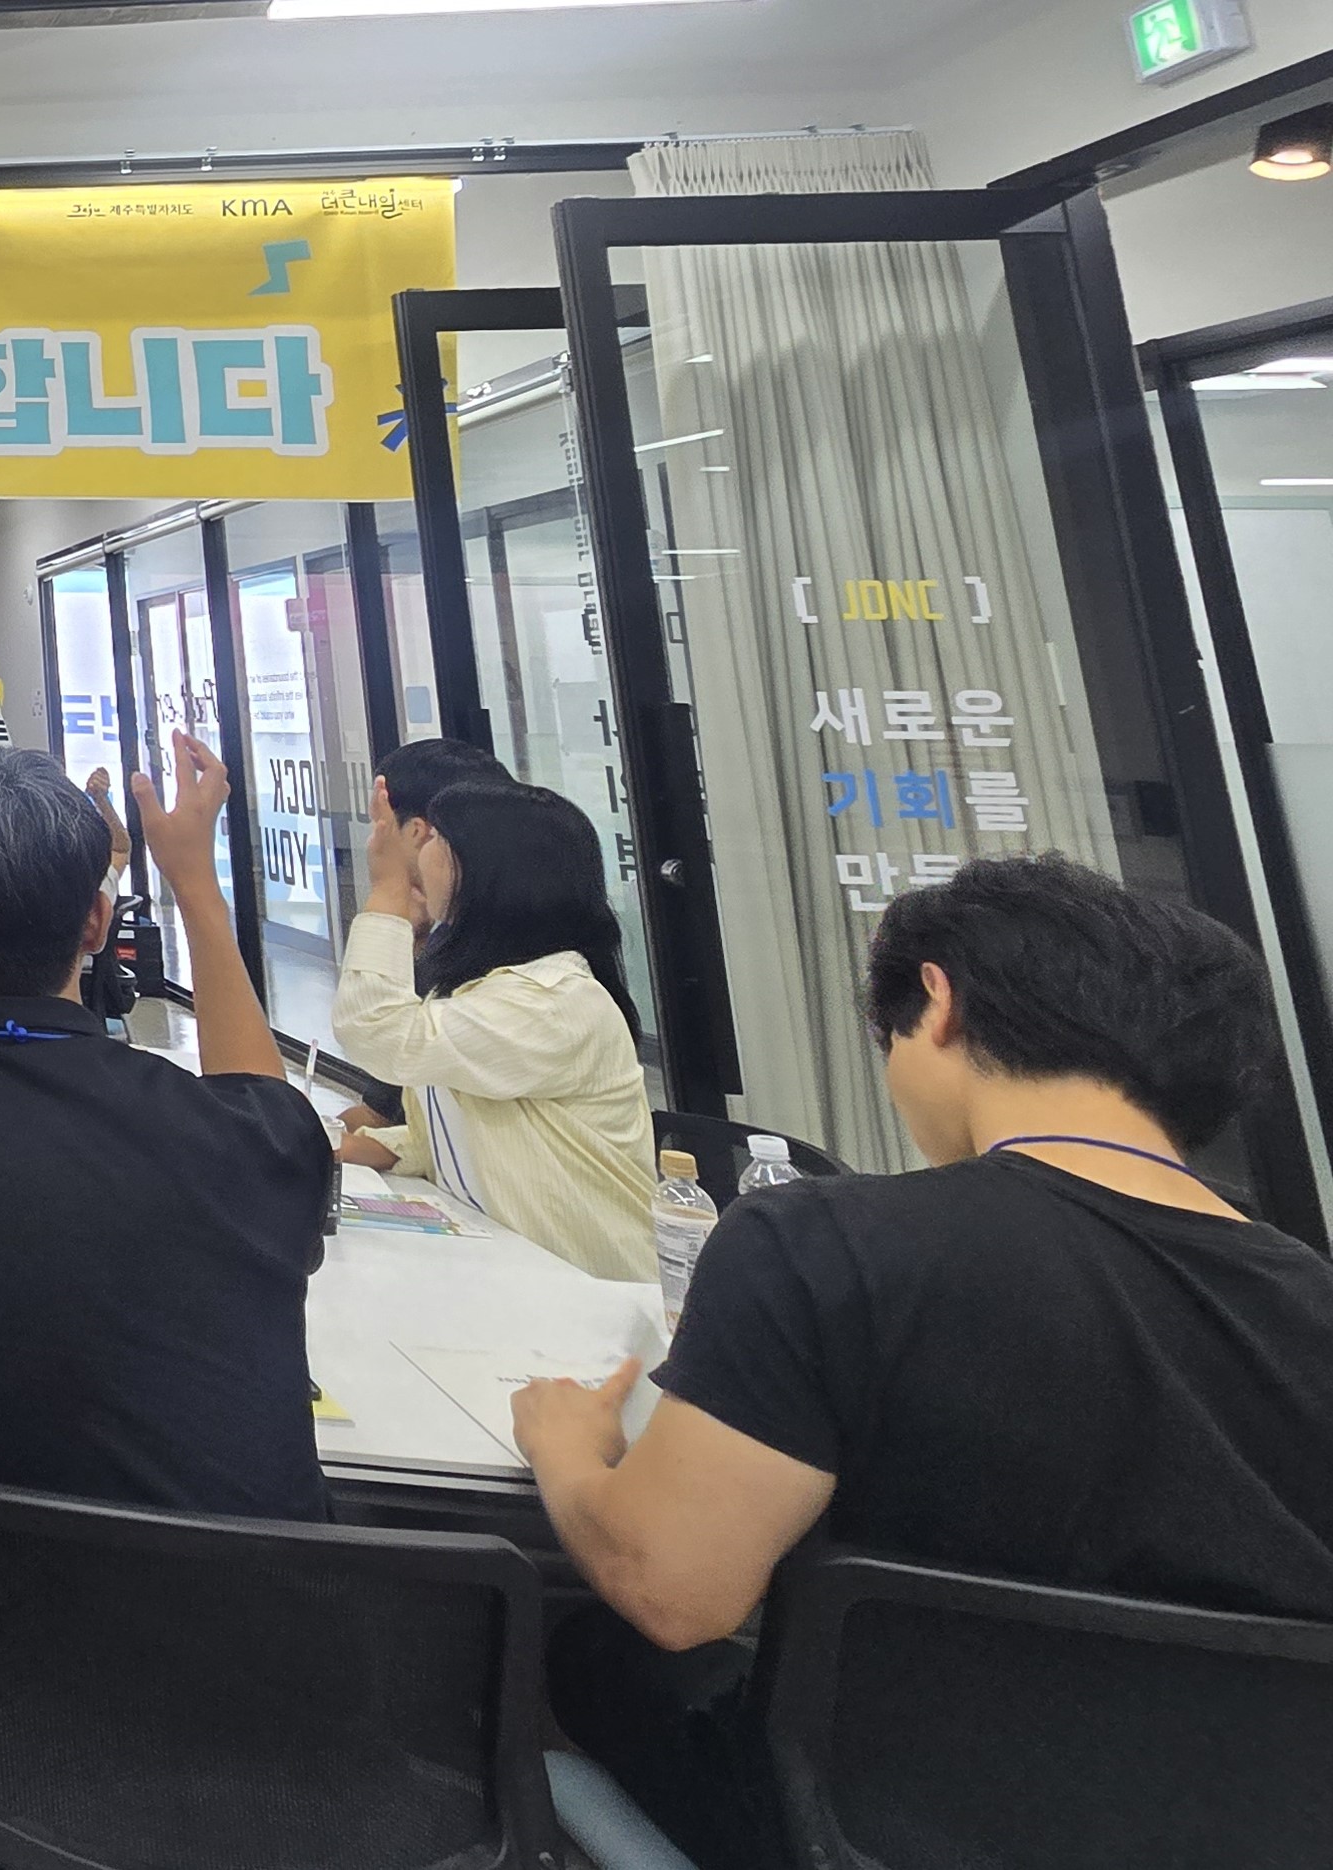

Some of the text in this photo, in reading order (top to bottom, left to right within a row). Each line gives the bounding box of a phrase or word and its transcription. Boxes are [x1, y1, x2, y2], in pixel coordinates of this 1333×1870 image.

[109, 203, 195, 217] 제주특별자치도
[221, 198, 294, 217] KMA
[842, 579, 945, 621] JDNC
[810, 687, 1015, 748] 새로운
[822, 768, 1030, 832] 기회를
